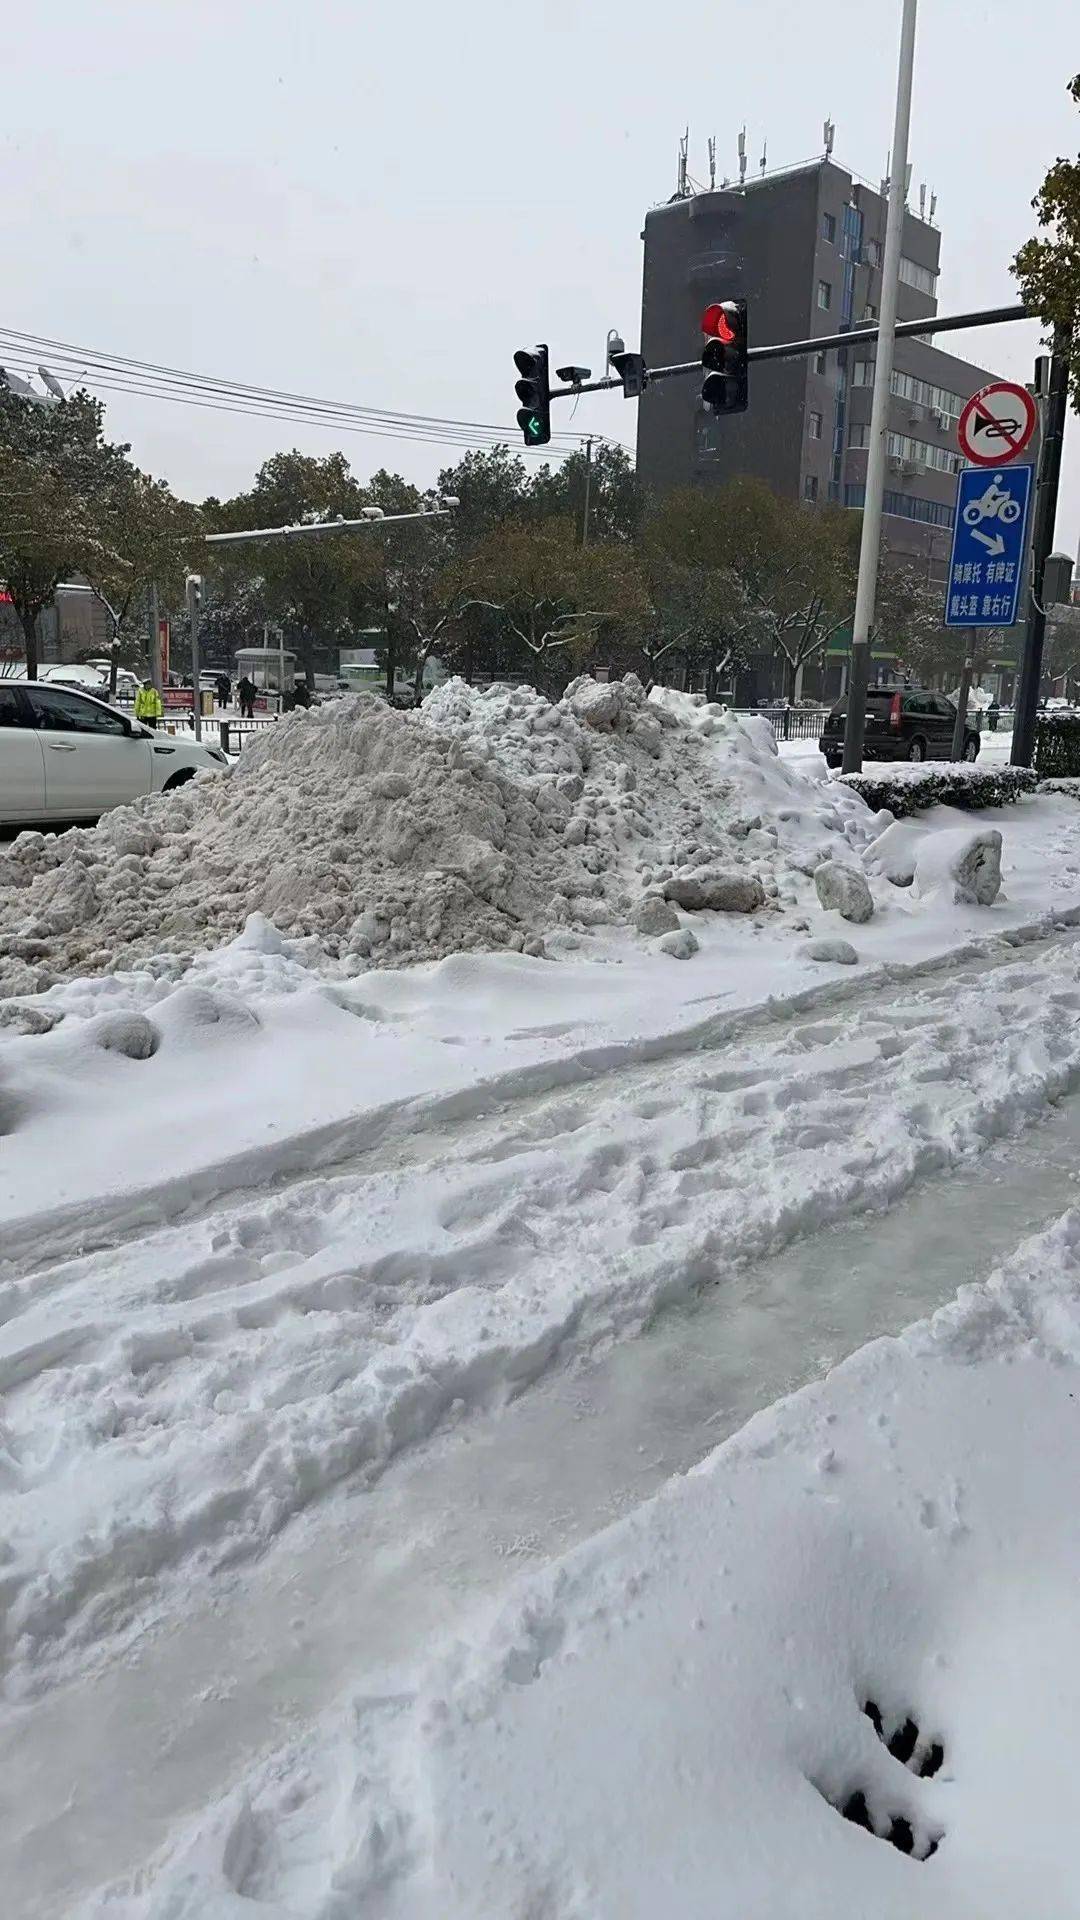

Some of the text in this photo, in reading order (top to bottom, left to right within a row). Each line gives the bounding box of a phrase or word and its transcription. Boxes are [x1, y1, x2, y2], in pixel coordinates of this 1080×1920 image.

[953, 561, 1015, 584] 骑摩托 有牌证
[950, 594, 1011, 616] 戴头盔 靠右行
